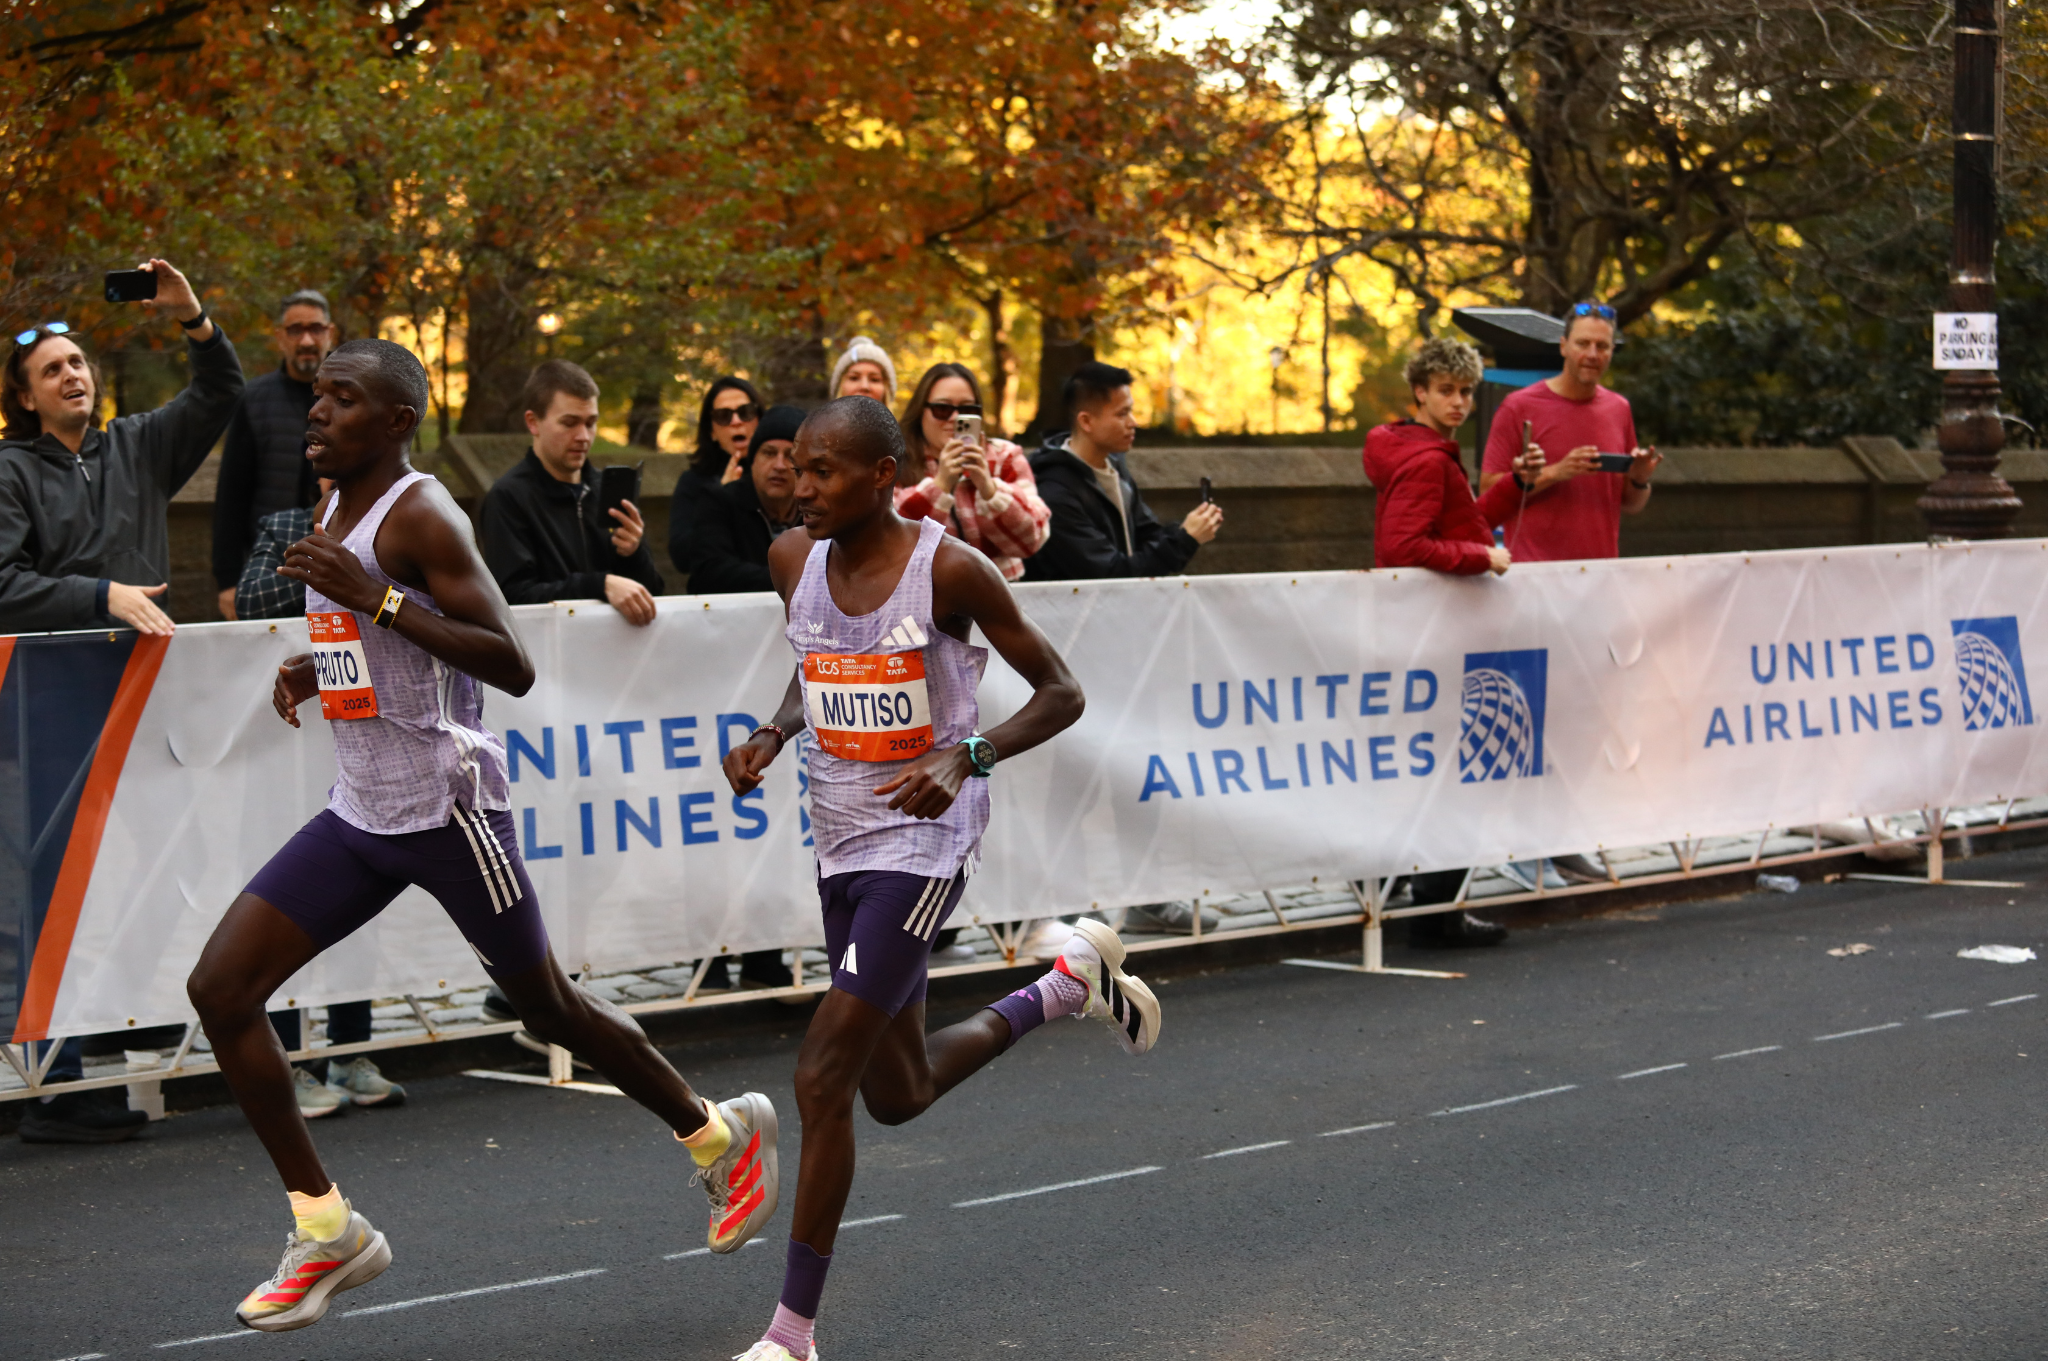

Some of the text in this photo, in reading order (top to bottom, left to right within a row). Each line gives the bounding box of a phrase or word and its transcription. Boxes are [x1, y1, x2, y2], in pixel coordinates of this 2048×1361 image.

[1954, 317, 1968, 329] NO
[1939, 331, 1986, 345] PARKING
[1941, 347, 1985, 361] SUNDAY
[814, 635, 839, 646] Angels
[816, 657, 840, 675] tcs
[1751, 632, 1936, 685] UNITED
[886, 667, 908, 676] TATA
[342, 697, 371, 711] 2025
[1191, 668, 1439, 729] UNITED
[821, 691, 913, 727] MUTISO
[1703, 687, 1944, 749] AIRLINES
[889, 735, 927, 751] 2025
[1138, 731, 1437, 803] AIRLINES
